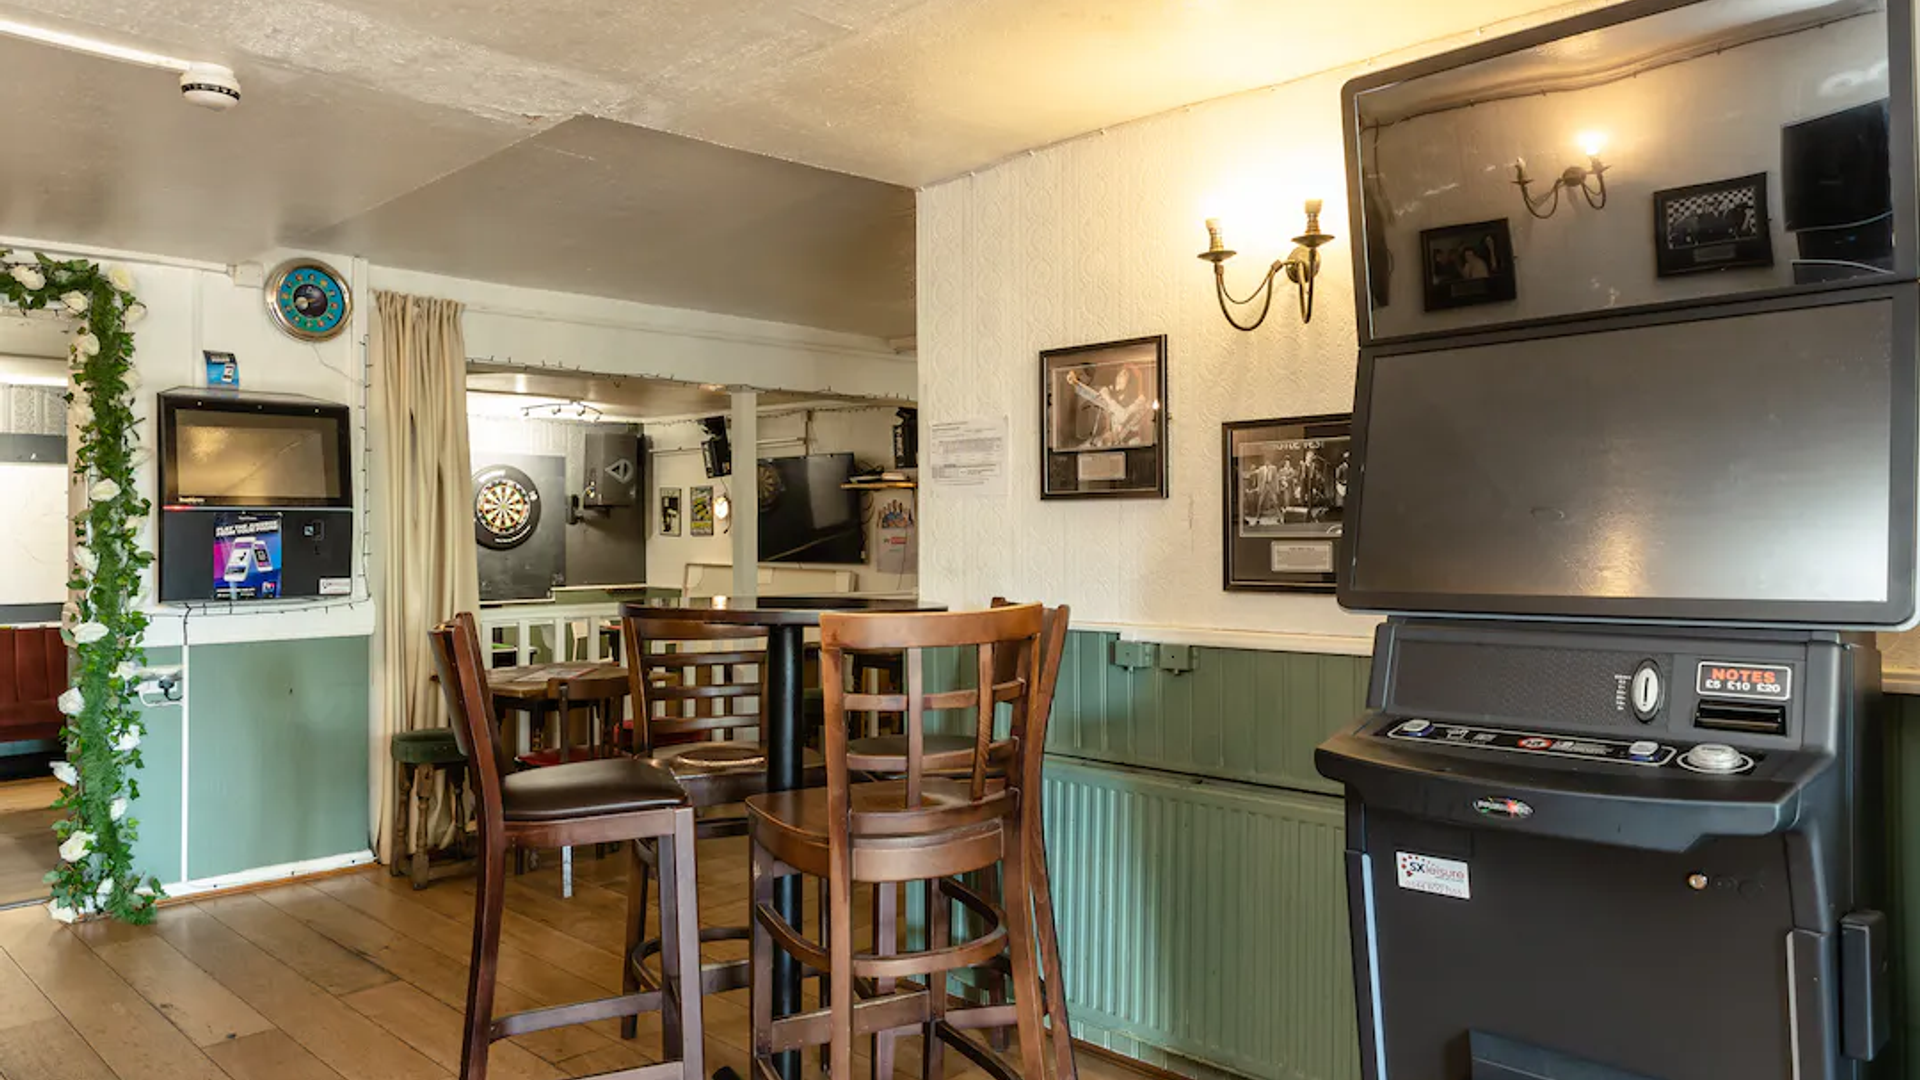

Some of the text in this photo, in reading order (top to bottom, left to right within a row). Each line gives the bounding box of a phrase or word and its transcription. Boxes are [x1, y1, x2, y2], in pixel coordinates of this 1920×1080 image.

[1711, 667, 1776, 683] NOTES
[1705, 679, 1781, 693] £5 £10 £20
